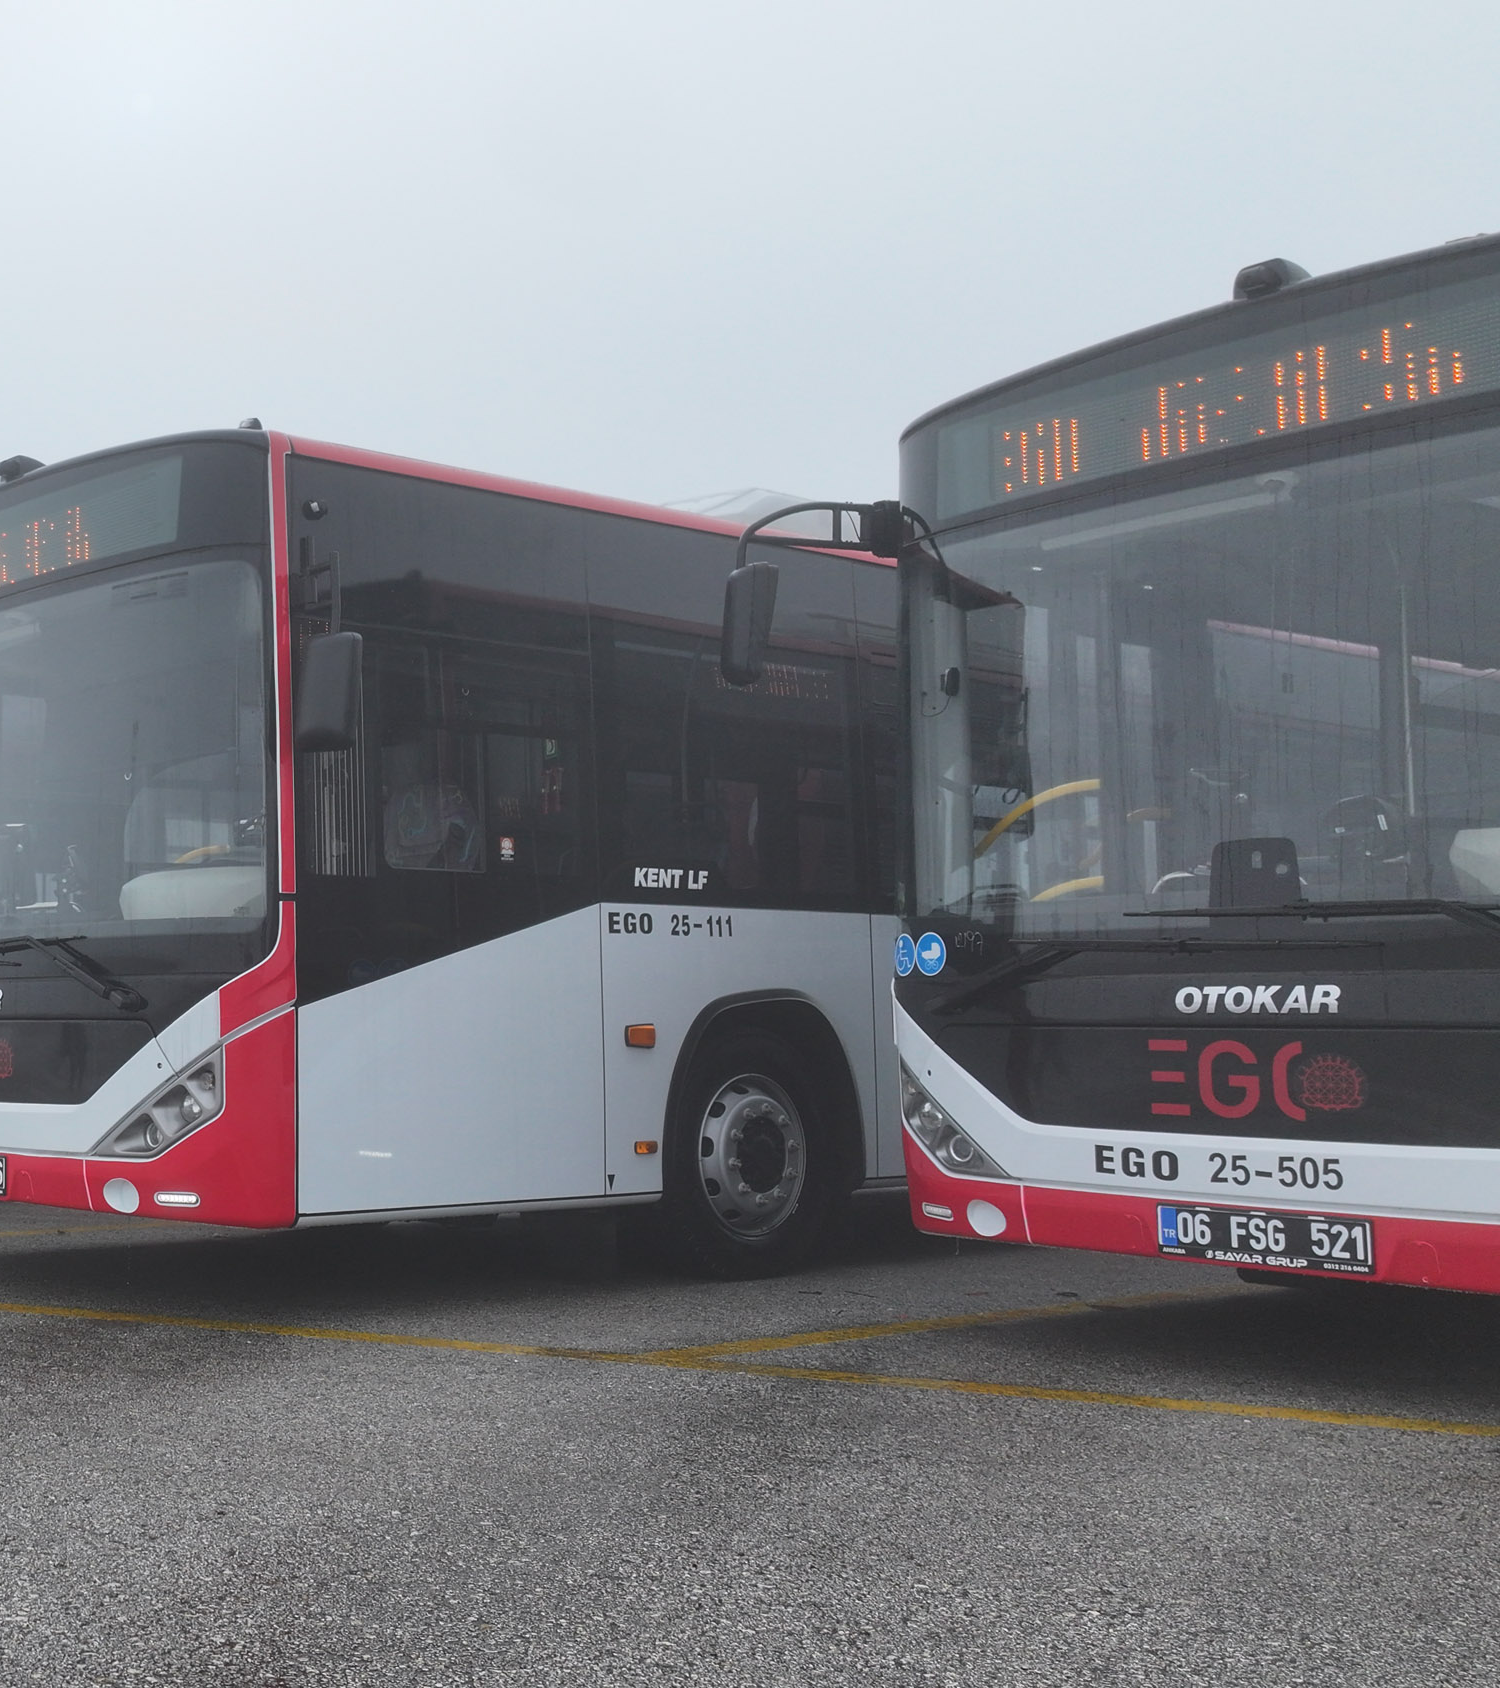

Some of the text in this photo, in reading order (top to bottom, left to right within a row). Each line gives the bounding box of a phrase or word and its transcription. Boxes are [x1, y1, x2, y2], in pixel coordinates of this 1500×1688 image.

[634, 867, 709, 890] KENT LF
[608, 912, 732, 937] EGO 25-111
[1175, 984, 1342, 1014] OTOKAR
[1094, 1144, 1344, 1190] EGO 25-505
[1163, 1211, 1365, 1260] TR 06 FSG 521
[1214, 1251, 1308, 1268] SAYAR GRUP
